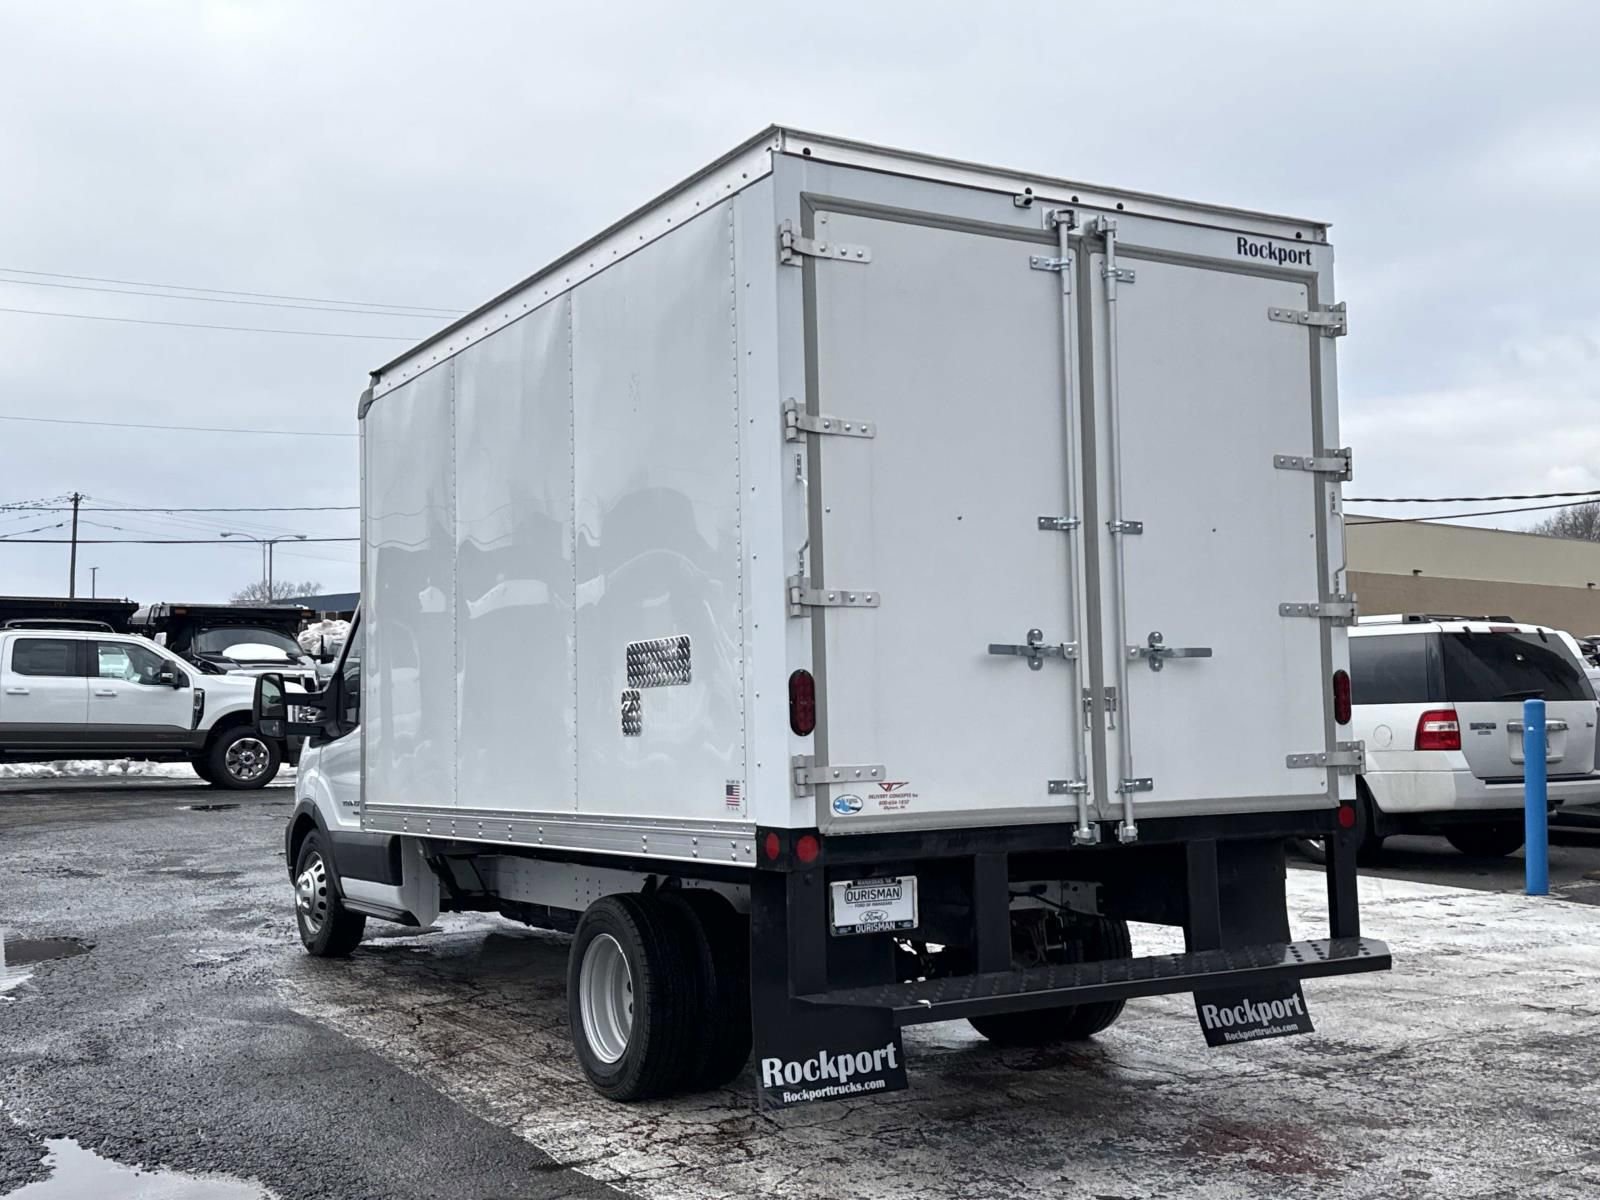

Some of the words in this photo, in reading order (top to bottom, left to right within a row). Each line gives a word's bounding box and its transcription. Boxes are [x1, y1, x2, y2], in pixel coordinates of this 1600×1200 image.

[1237, 236, 1312, 266] Rockport
[846, 887, 900, 902] OURISMAN
[855, 921, 896, 933] OURISMAN
[1201, 992, 1304, 1030] Rockport
[1224, 1023, 1299, 1041] Rockporttrucks.com
[761, 1042, 899, 1088] Rockport
[783, 1078, 886, 1103] Rockporttrucks.com
